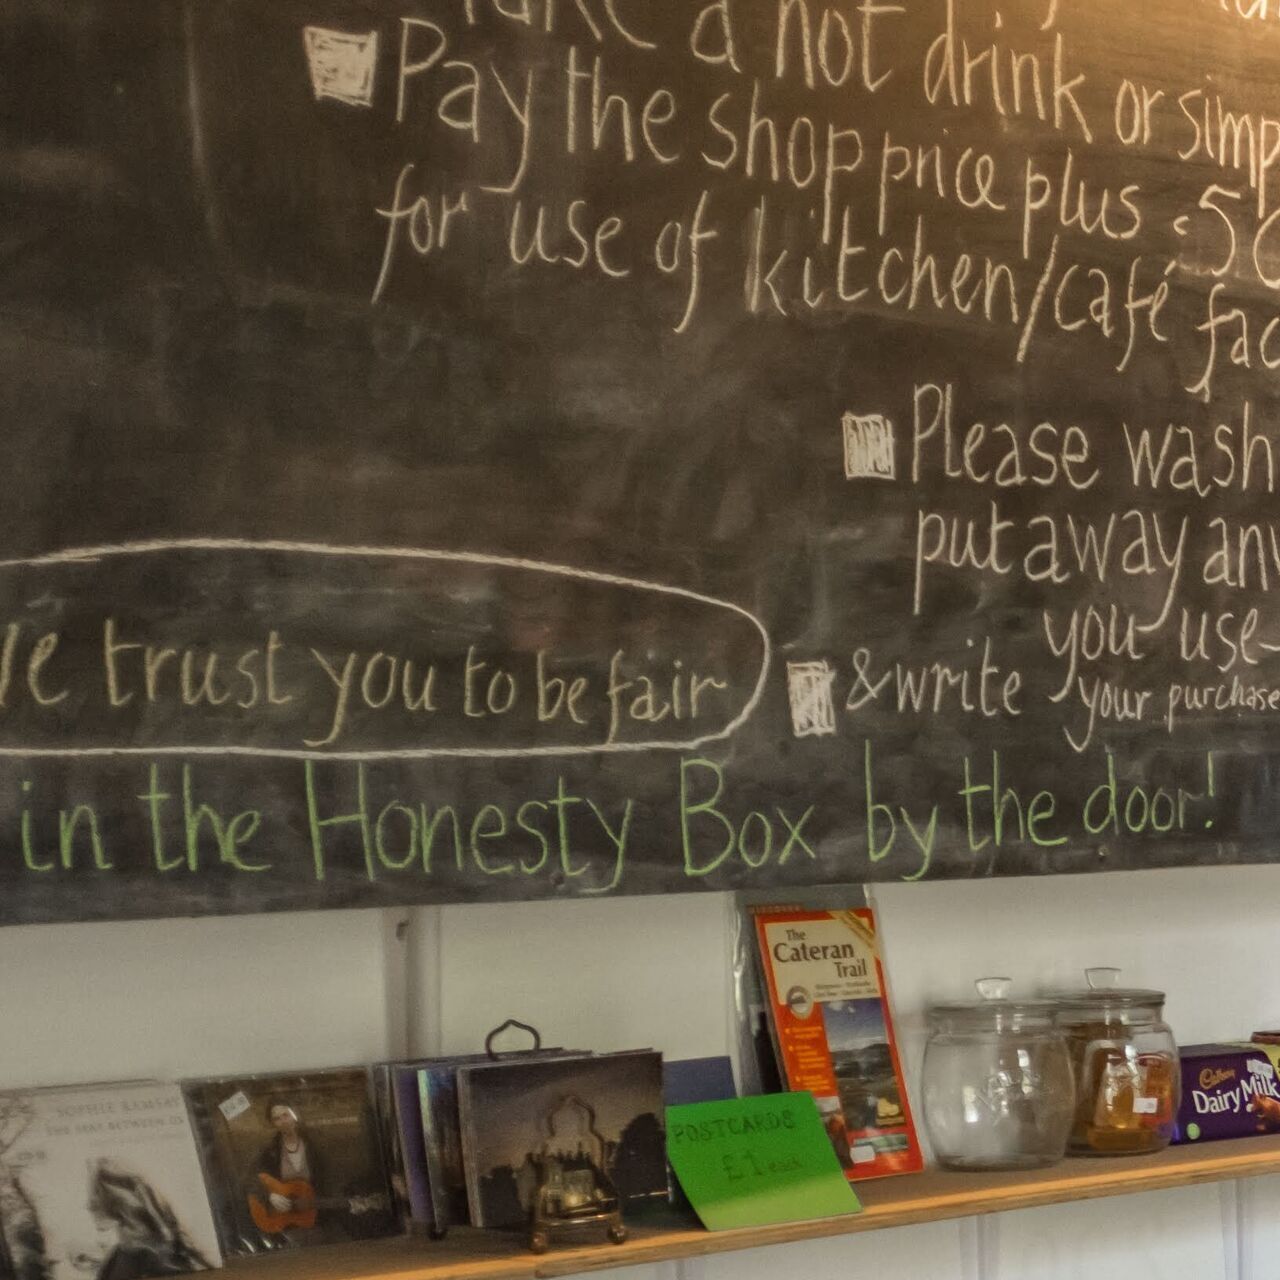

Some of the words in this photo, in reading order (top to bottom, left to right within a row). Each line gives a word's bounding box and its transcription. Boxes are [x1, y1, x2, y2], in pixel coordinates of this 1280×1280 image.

[924, 0, 1092, 143] drink
[1115, 80, 1164, 145] or
[397, 17, 533, 192] Pay
[565, 47, 680, 163] the
[701, 79, 863, 244] shop
[879, 128, 1006, 236] price
[1023, 149, 1141, 259] plus
[375, 164, 468, 304] for
[509, 200, 629, 277] use
[655, 190, 716, 333] of
[912, 383, 1098, 488] Please
[1123, 402, 1275, 497] wash
[915, 502, 1014, 615] put
[1024, 510, 1189, 632] away
[103, 617, 294, 708] trust
[304, 646, 437, 747] you
[463, 645, 516, 718] to
[537, 648, 588, 725] be
[605, 646, 727, 745] fair
[846, 647, 895, 709] &
[897, 640, 1021, 718] write
[1063, 672, 1150, 753] your
[1043, 605, 1146, 701] you
[1181, 606, 1262, 672] use
[21, 780, 113, 872] in
[138, 762, 272, 873] the
[304, 759, 632, 894] Honesty
[679, 756, 815, 877] Box
[865, 739, 938, 881] by
[958, 750, 1067, 852] the
[1083, 750, 1216, 834] door!
[774, 942, 854, 962] Cateran
[786, 929, 806, 940] The
[834, 959, 867, 978] Trail
[1192, 1087, 1241, 1114] Dairy
